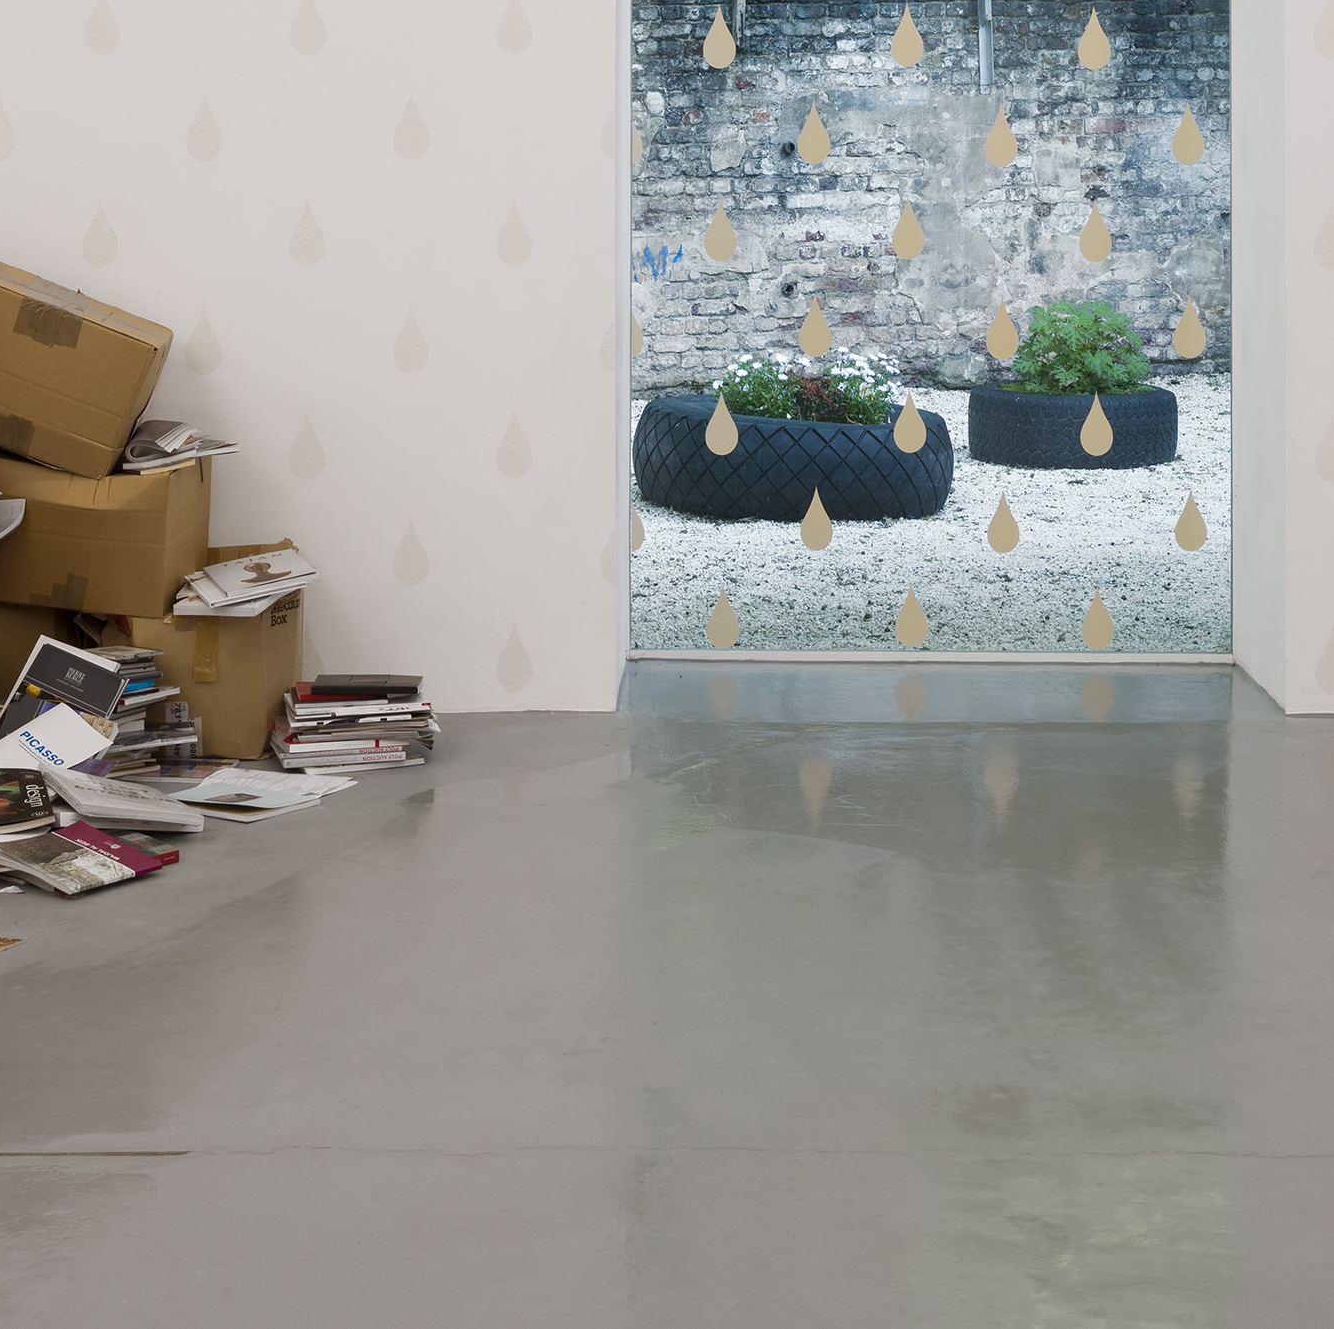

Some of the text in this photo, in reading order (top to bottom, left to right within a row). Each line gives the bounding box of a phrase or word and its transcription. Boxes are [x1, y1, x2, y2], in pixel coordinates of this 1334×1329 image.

[270, 614, 288, 627] Box
[19, 730, 65, 767] PICASSO
[24, 784, 46, 808] design
